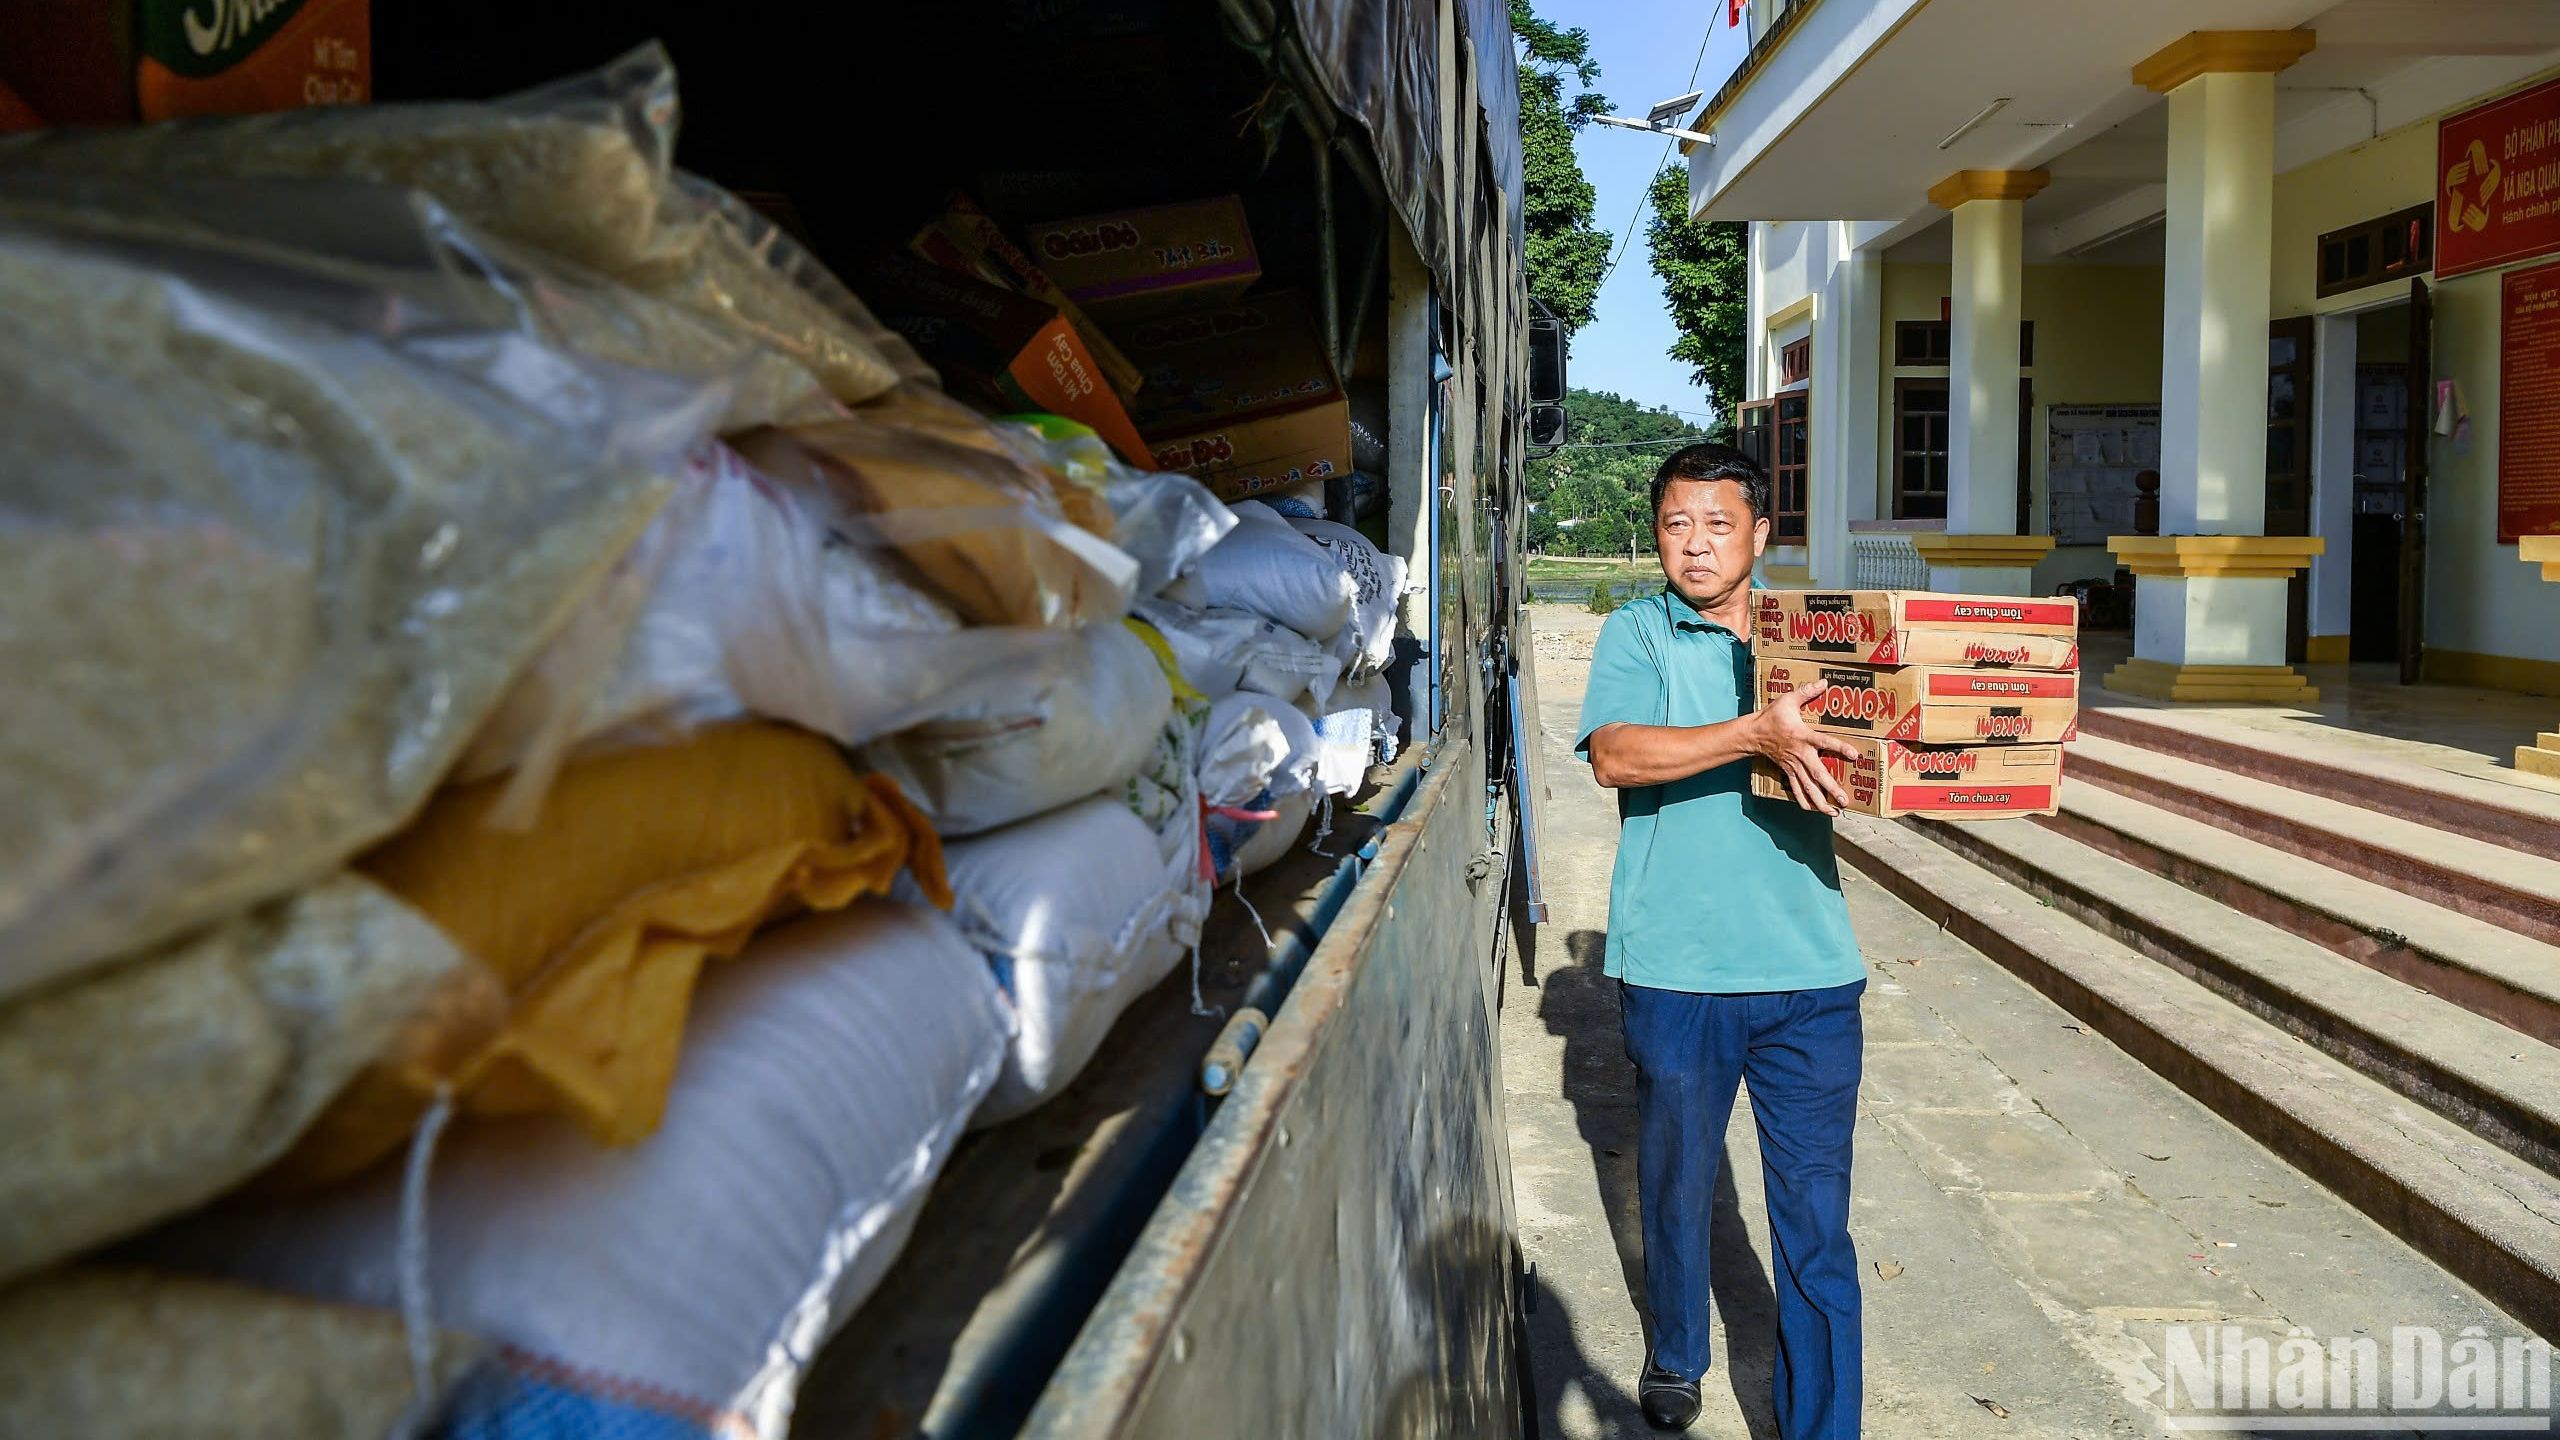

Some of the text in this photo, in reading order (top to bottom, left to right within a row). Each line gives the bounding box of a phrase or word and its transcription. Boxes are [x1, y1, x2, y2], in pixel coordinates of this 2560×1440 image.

[2517, 168, 2536, 199] NGA
[1155, 445, 1194, 469] ấu
[1236, 460, 1334, 493] Tôm và Gà
[1762, 595, 1779, 610] cay
[1954, 604, 1972, 616] cay
[1760, 610, 1784, 626] chua
[1974, 607, 1999, 619] chua
[2000, 608, 2023, 620] Tôm
[1761, 627, 1784, 642] Tôm
[1788, 611, 1876, 644] KOKOMI
[1964, 642, 2030, 663] KOKOMI
[1770, 665, 1790, 680] cay
[1971, 680, 1986, 691] cay
[1988, 682, 2008, 694] chua
[2012, 682, 2031, 694] Tôm
[1897, 714, 1917, 737] MỚI
[1976, 715, 2032, 738] KOKOMI
[1904, 752, 1978, 773] KOKOMI
[1850, 771, 1876, 789] chua
[1854, 788, 1873, 806] cay
[1949, 792, 1969, 803] Tôm
[1971, 792, 1994, 803] chua
[1995, 794, 2010, 804] cay
